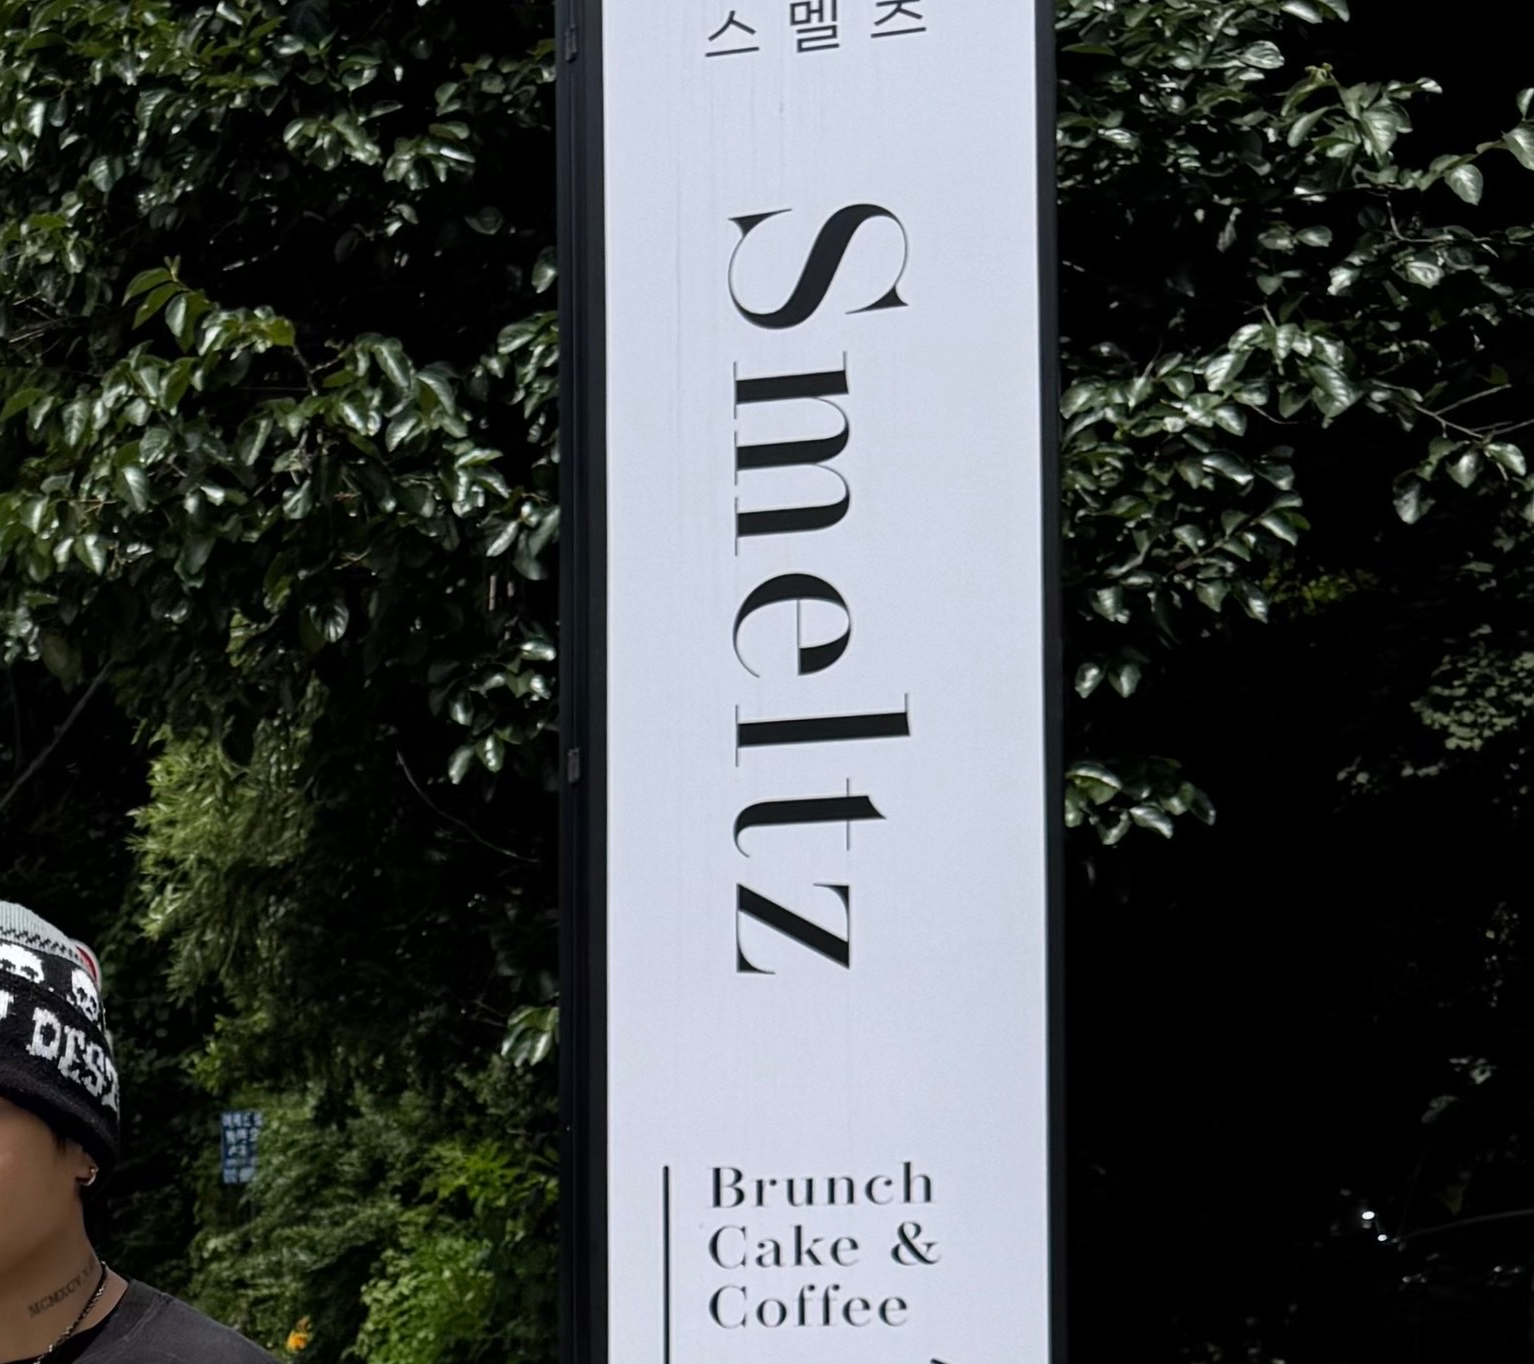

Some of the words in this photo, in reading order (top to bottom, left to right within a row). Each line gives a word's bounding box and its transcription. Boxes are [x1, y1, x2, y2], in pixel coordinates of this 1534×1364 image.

[728, 203, 911, 975] Smeltz
[709, 1161, 933, 1209] Brunch
[708, 1224, 860, 1269] Cake
[890, 1221, 941, 1266] &
[708, 1283, 909, 1328] Coffee
